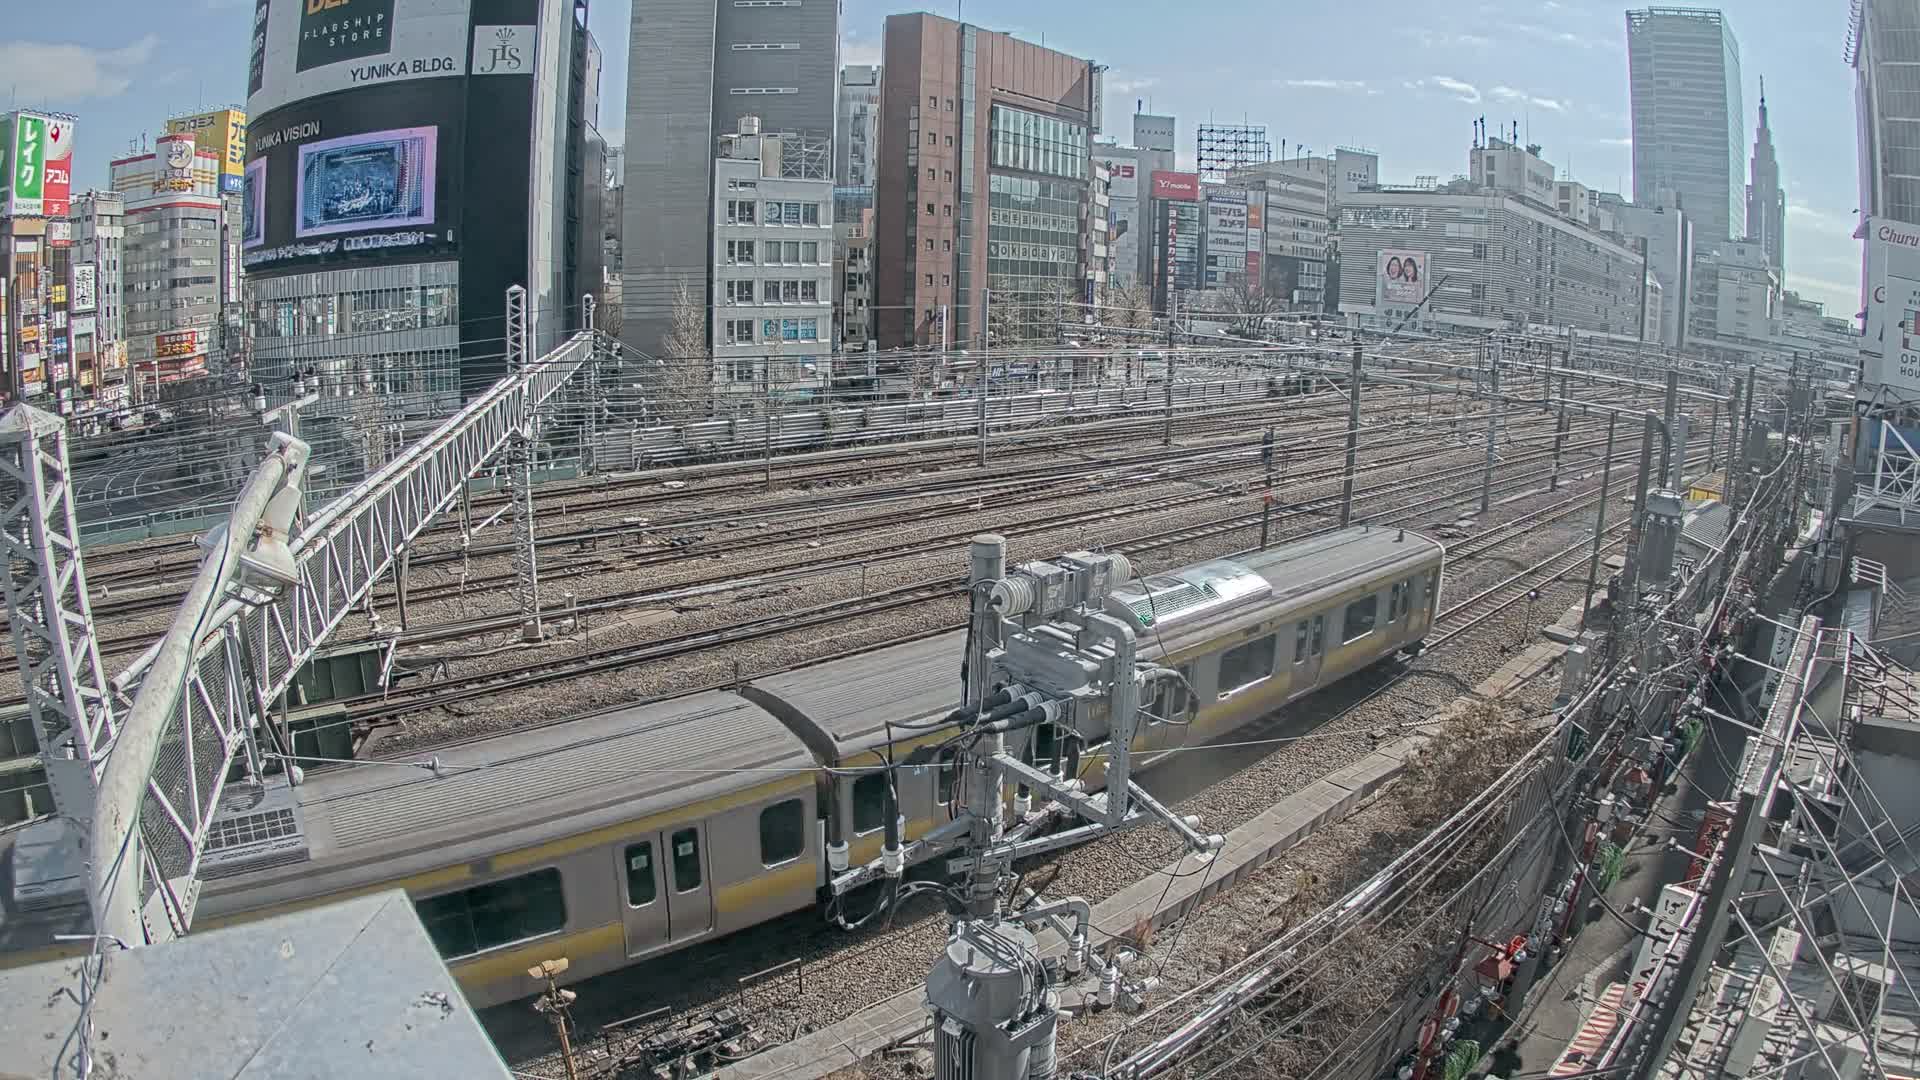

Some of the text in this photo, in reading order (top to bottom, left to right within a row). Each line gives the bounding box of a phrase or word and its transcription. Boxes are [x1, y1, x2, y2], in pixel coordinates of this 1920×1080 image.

[304, 14, 384, 40] FLAGSHIP
[329, 28, 383, 47] STORE
[351, 57, 456, 82] YUNIKA BLDG.
[175, 115, 215, 132] プロミス
[255, 120, 320, 152] YUNIKA VISION
[22, 120, 38, 187] レイク
[46, 168, 69, 184] アコム
[1001, 243, 1066, 260] okadaya
